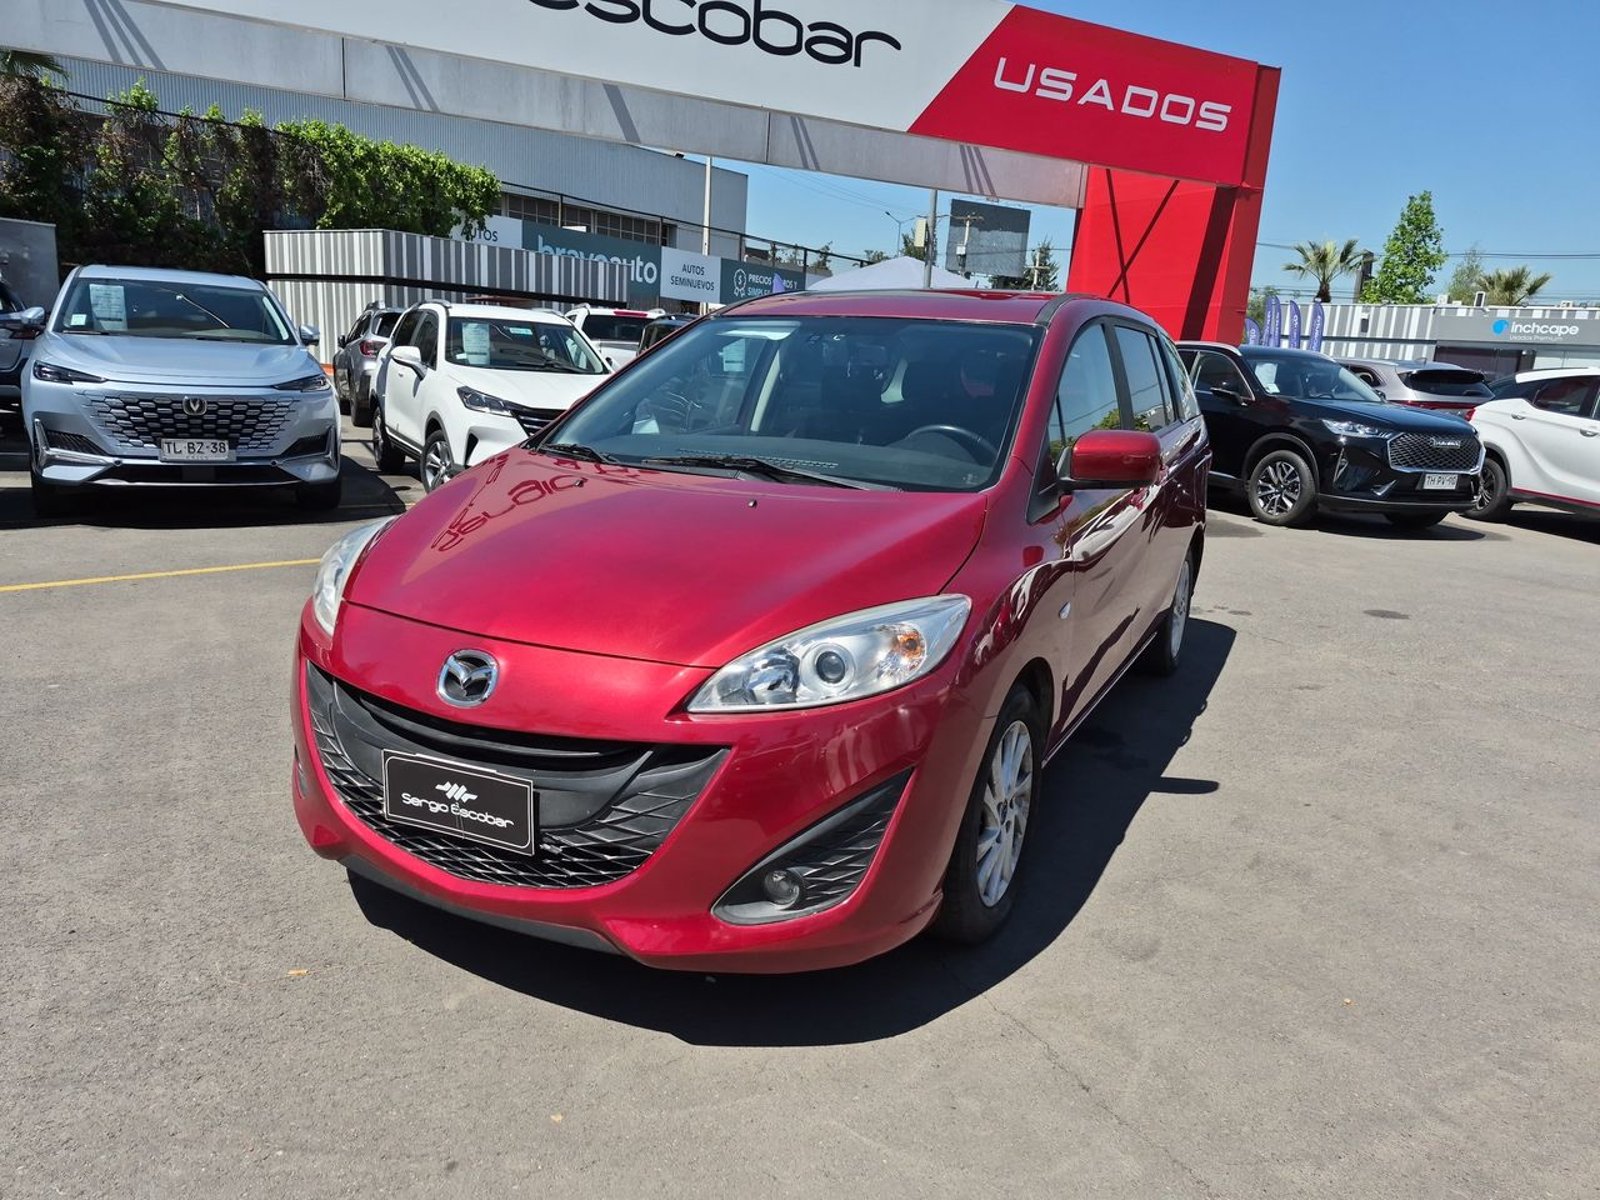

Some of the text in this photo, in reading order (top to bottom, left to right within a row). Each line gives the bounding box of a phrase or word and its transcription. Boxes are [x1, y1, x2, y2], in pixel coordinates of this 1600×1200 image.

[529, 0, 903, 67] scobar
[993, 57, 1232, 132] USADOS
[682, 264, 705, 276] AUTOS
[670, 275, 715, 291] SEMINUEVOS
[748, 273, 772, 286] PRECIOS
[1510, 321, 1579, 337] inchcape
